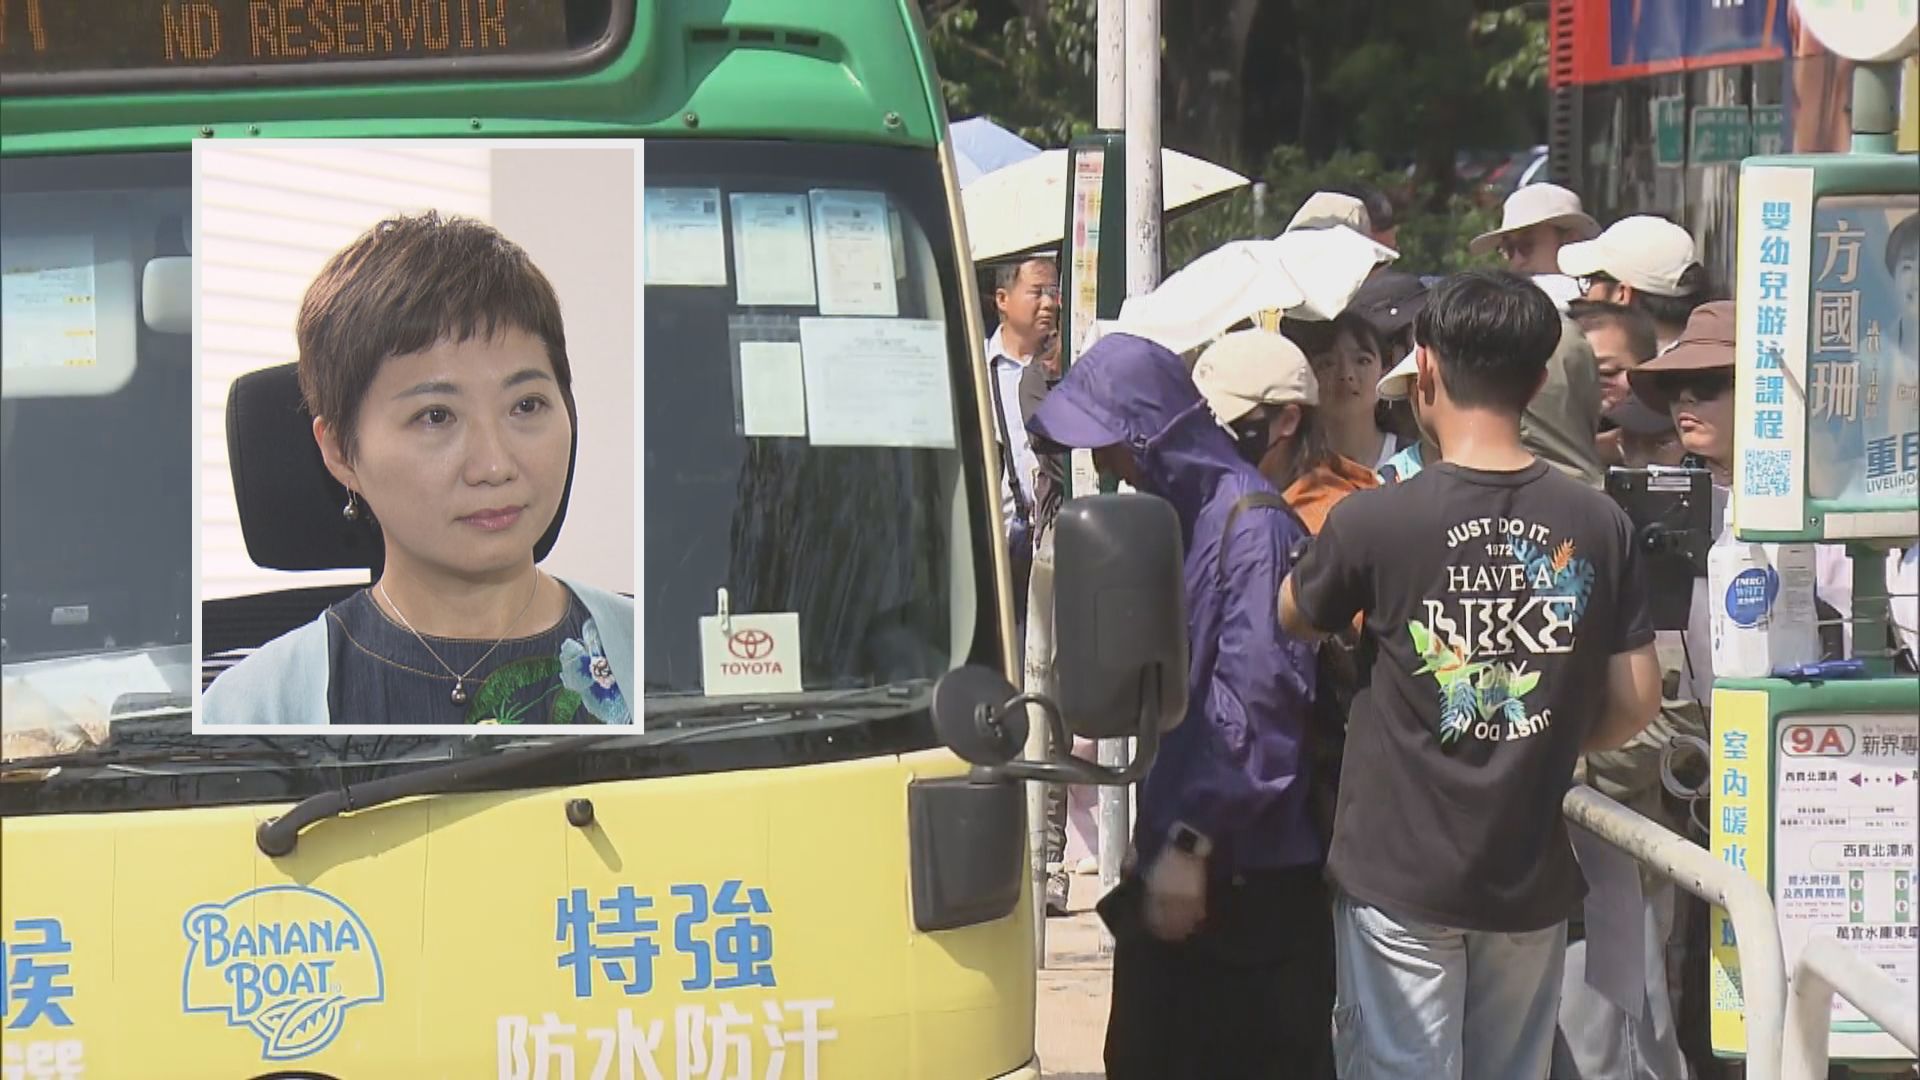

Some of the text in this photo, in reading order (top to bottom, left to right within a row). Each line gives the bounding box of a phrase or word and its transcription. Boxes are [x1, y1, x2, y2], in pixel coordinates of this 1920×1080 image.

[163, 2, 220, 60] ND
[1753, 202, 1792, 440] 嬰幼兒游泳課程
[1811, 219, 1865, 424] 方國珊
[1447, 518, 1550, 548] JUST DO IT.
[1485, 544, 1514, 556] 1972
[1447, 566, 1554, 592] HAVE A
[1422, 596, 1577, 656] NIKE
[720, 662, 784, 676] TOYOTA
[1474, 721, 1501, 741] DO
[1791, 727, 1845, 753] 9A
[1721, 731, 1749, 948] 室內暖水
[191, 913, 361, 967] BANANA
[556, 880, 777, 998] 特強
[225, 960, 335, 1016] BOAT
[497, 997, 838, 1080] 防水防汗
